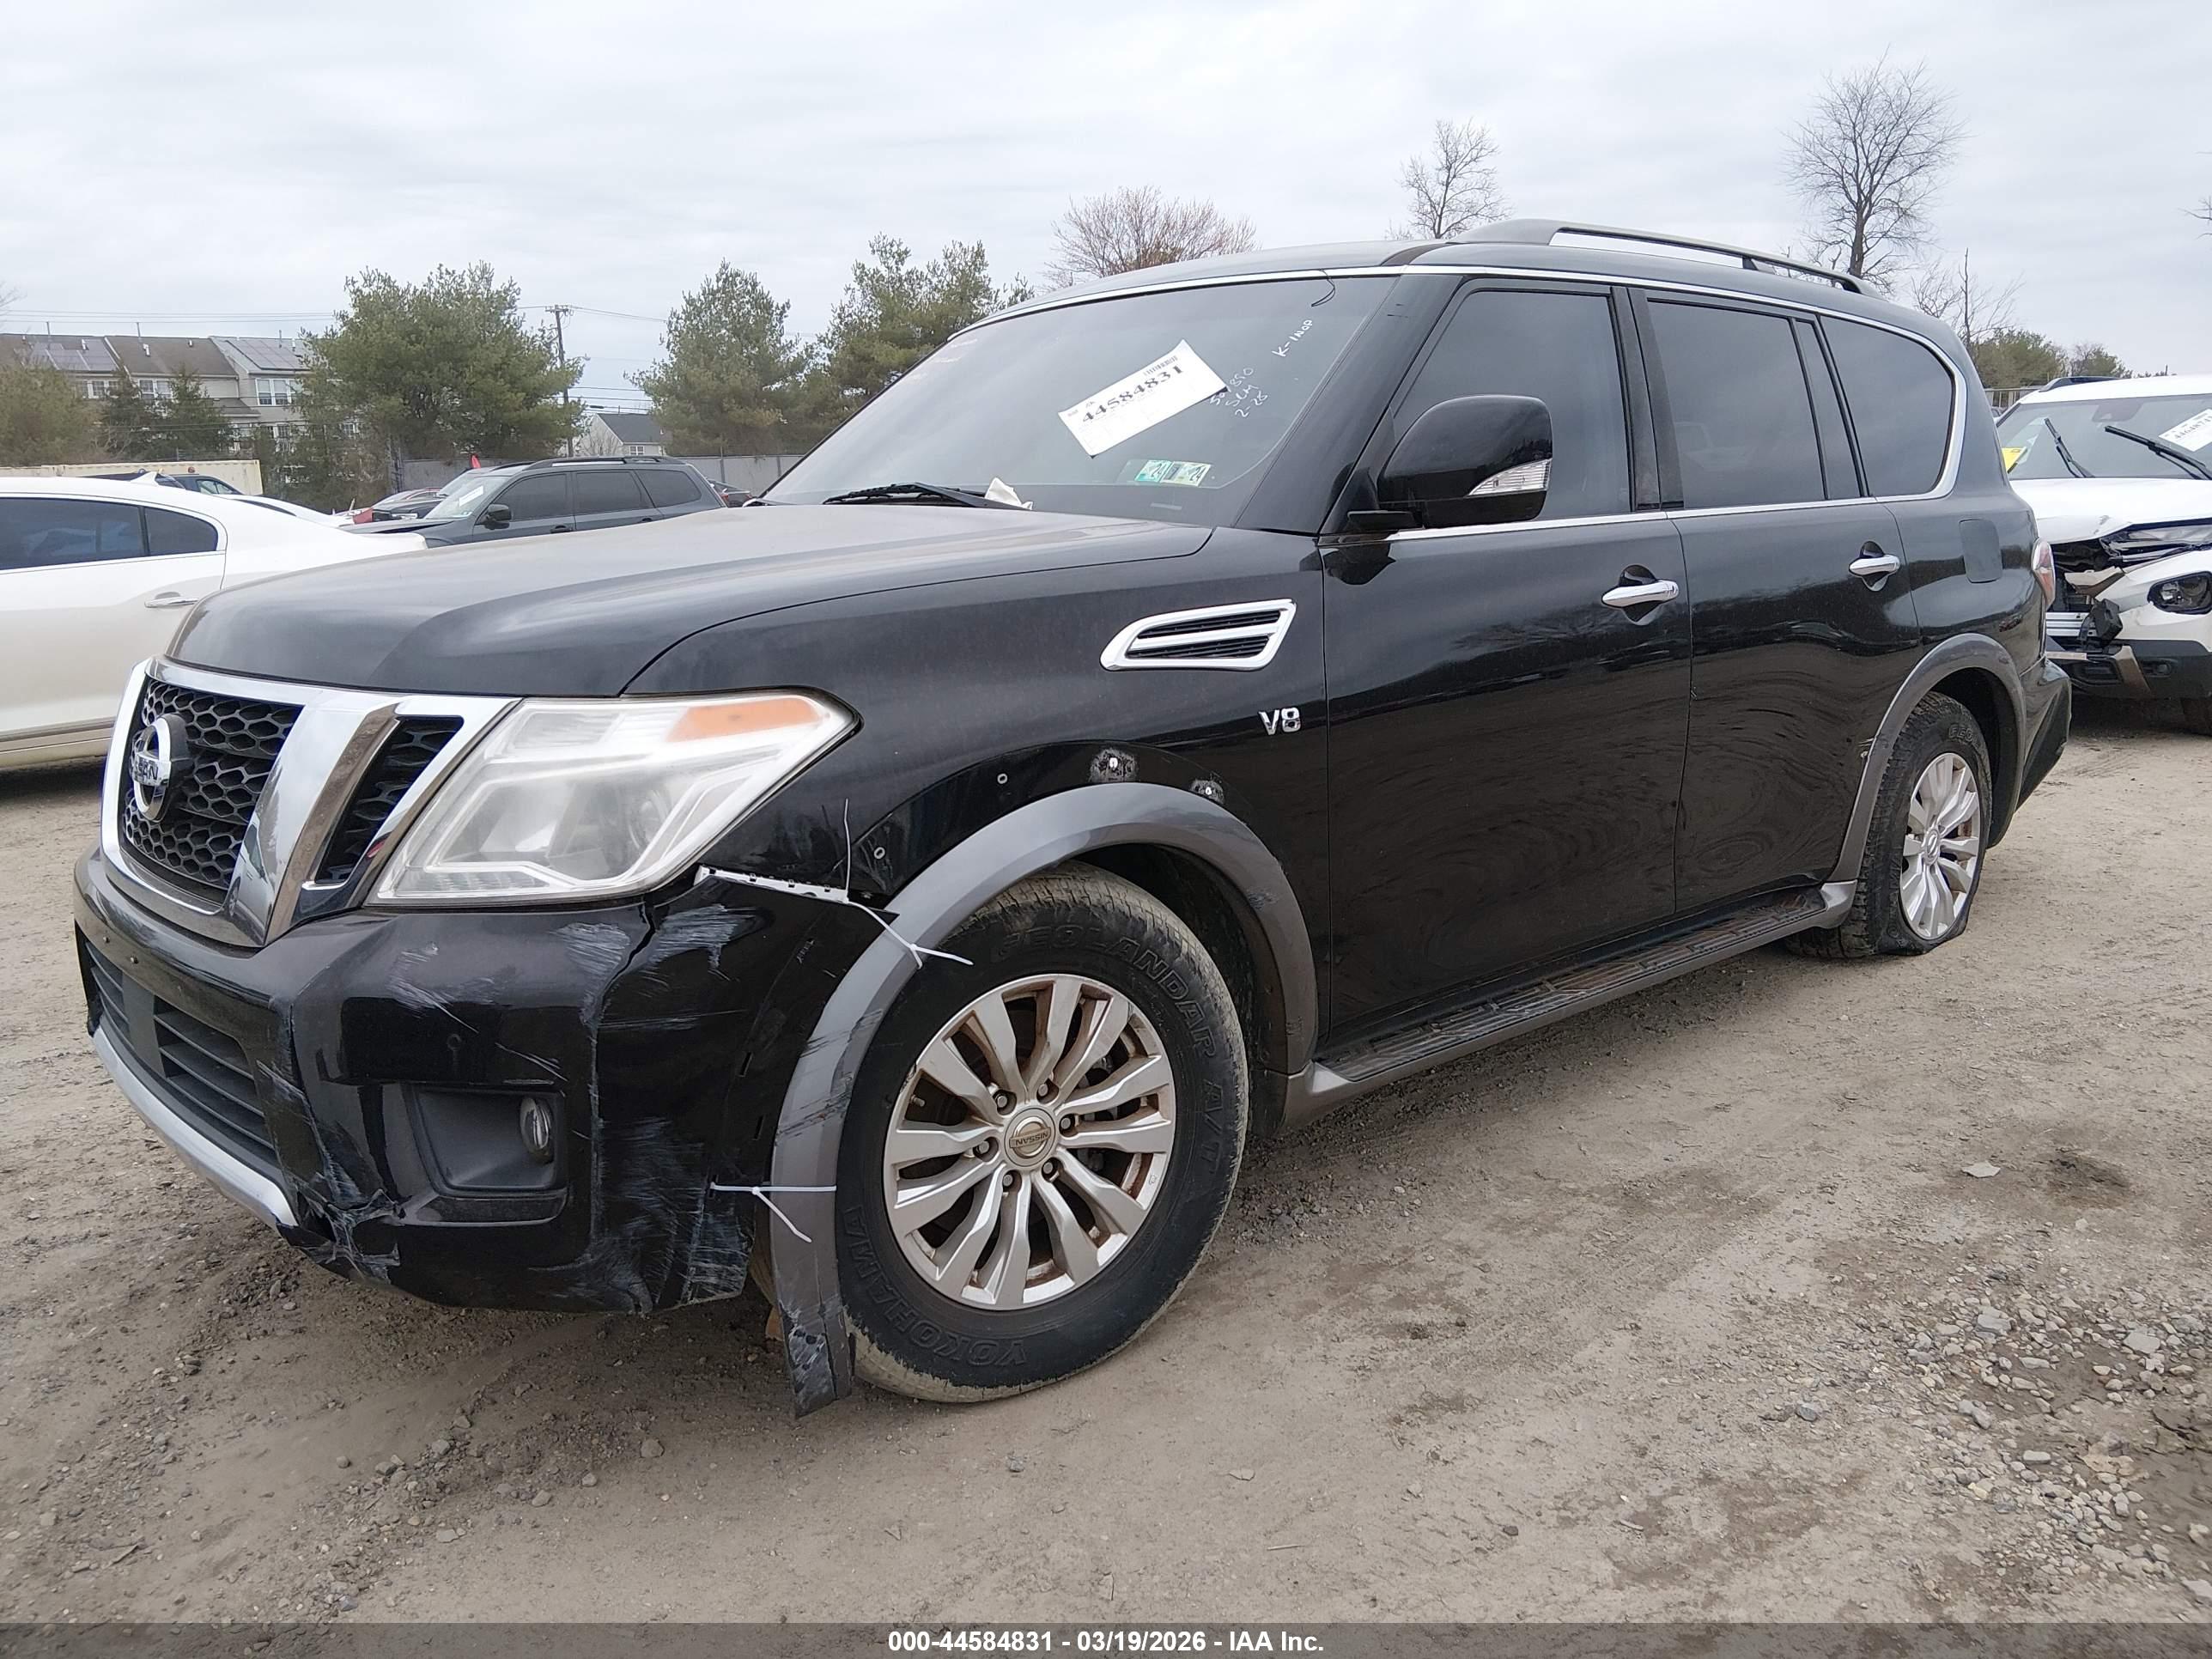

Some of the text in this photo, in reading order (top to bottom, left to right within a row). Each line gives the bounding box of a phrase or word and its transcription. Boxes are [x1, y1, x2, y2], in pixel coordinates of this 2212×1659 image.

[1082, 365, 1183, 422] 44584831
[1258, 707, 1302, 736] V8
[1015, 1130, 1049, 1146] NISSAN
[842, 1206, 1031, 1367] YOKOHAMA
